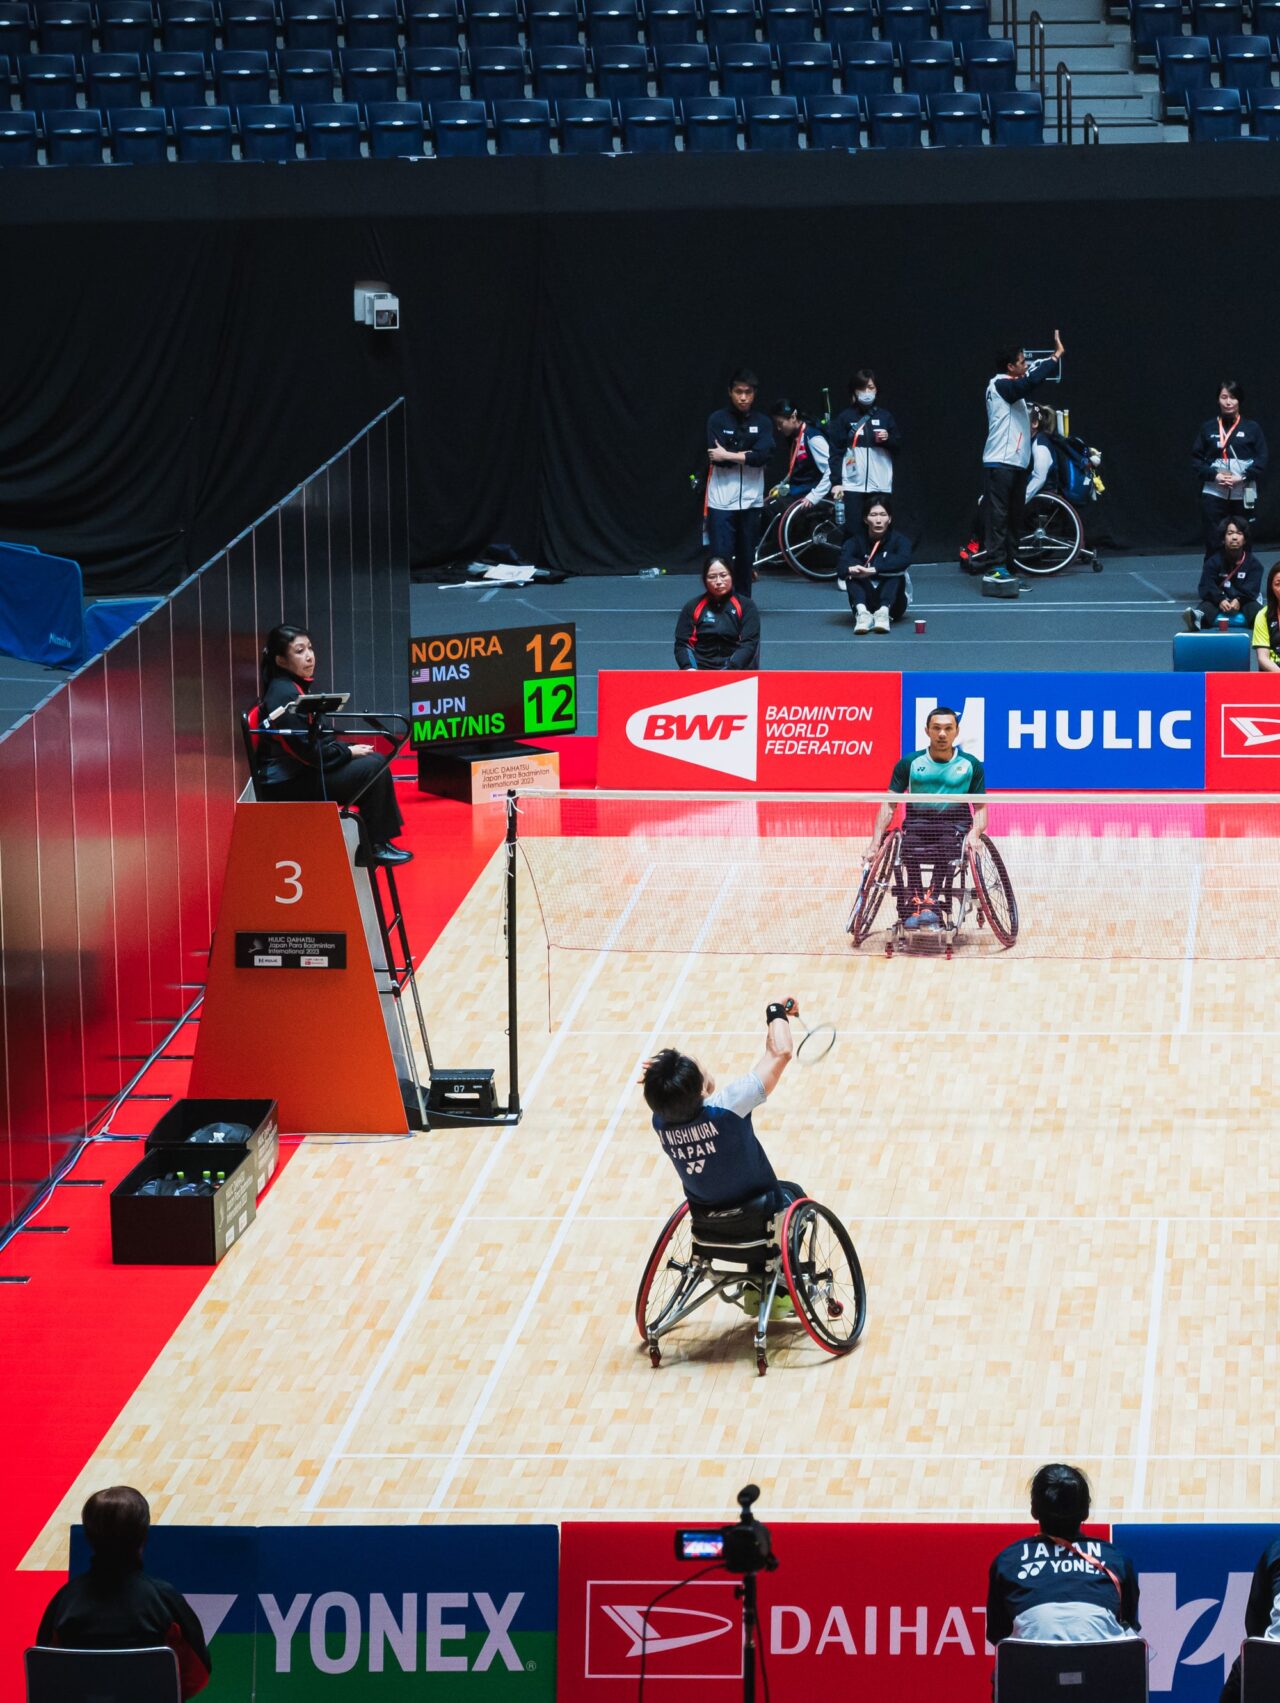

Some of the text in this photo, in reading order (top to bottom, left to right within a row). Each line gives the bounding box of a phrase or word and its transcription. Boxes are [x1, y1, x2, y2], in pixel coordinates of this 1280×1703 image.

[412, 635, 503, 664] NOO/RA
[526, 632, 573, 672] 12
[432, 664, 470, 682] MAS
[432, 696, 466, 715] JPN
[528, 684, 573, 724] 12
[765, 706, 873, 721] BADMINTON
[414, 713, 505, 742] MAT/NIS
[643, 714, 748, 740] BWF
[766, 723, 828, 738] WORLD
[1008, 710, 1192, 750] HULIC
[764, 740, 873, 756] FEDERATION
[275, 860, 303, 904] 3
[454, 1085, 466, 1093] 07
[666, 1120, 720, 1146] NISHIMURA
[670, 1141, 716, 1160] JAPAN
[258, 1591, 526, 1675] YONEX
